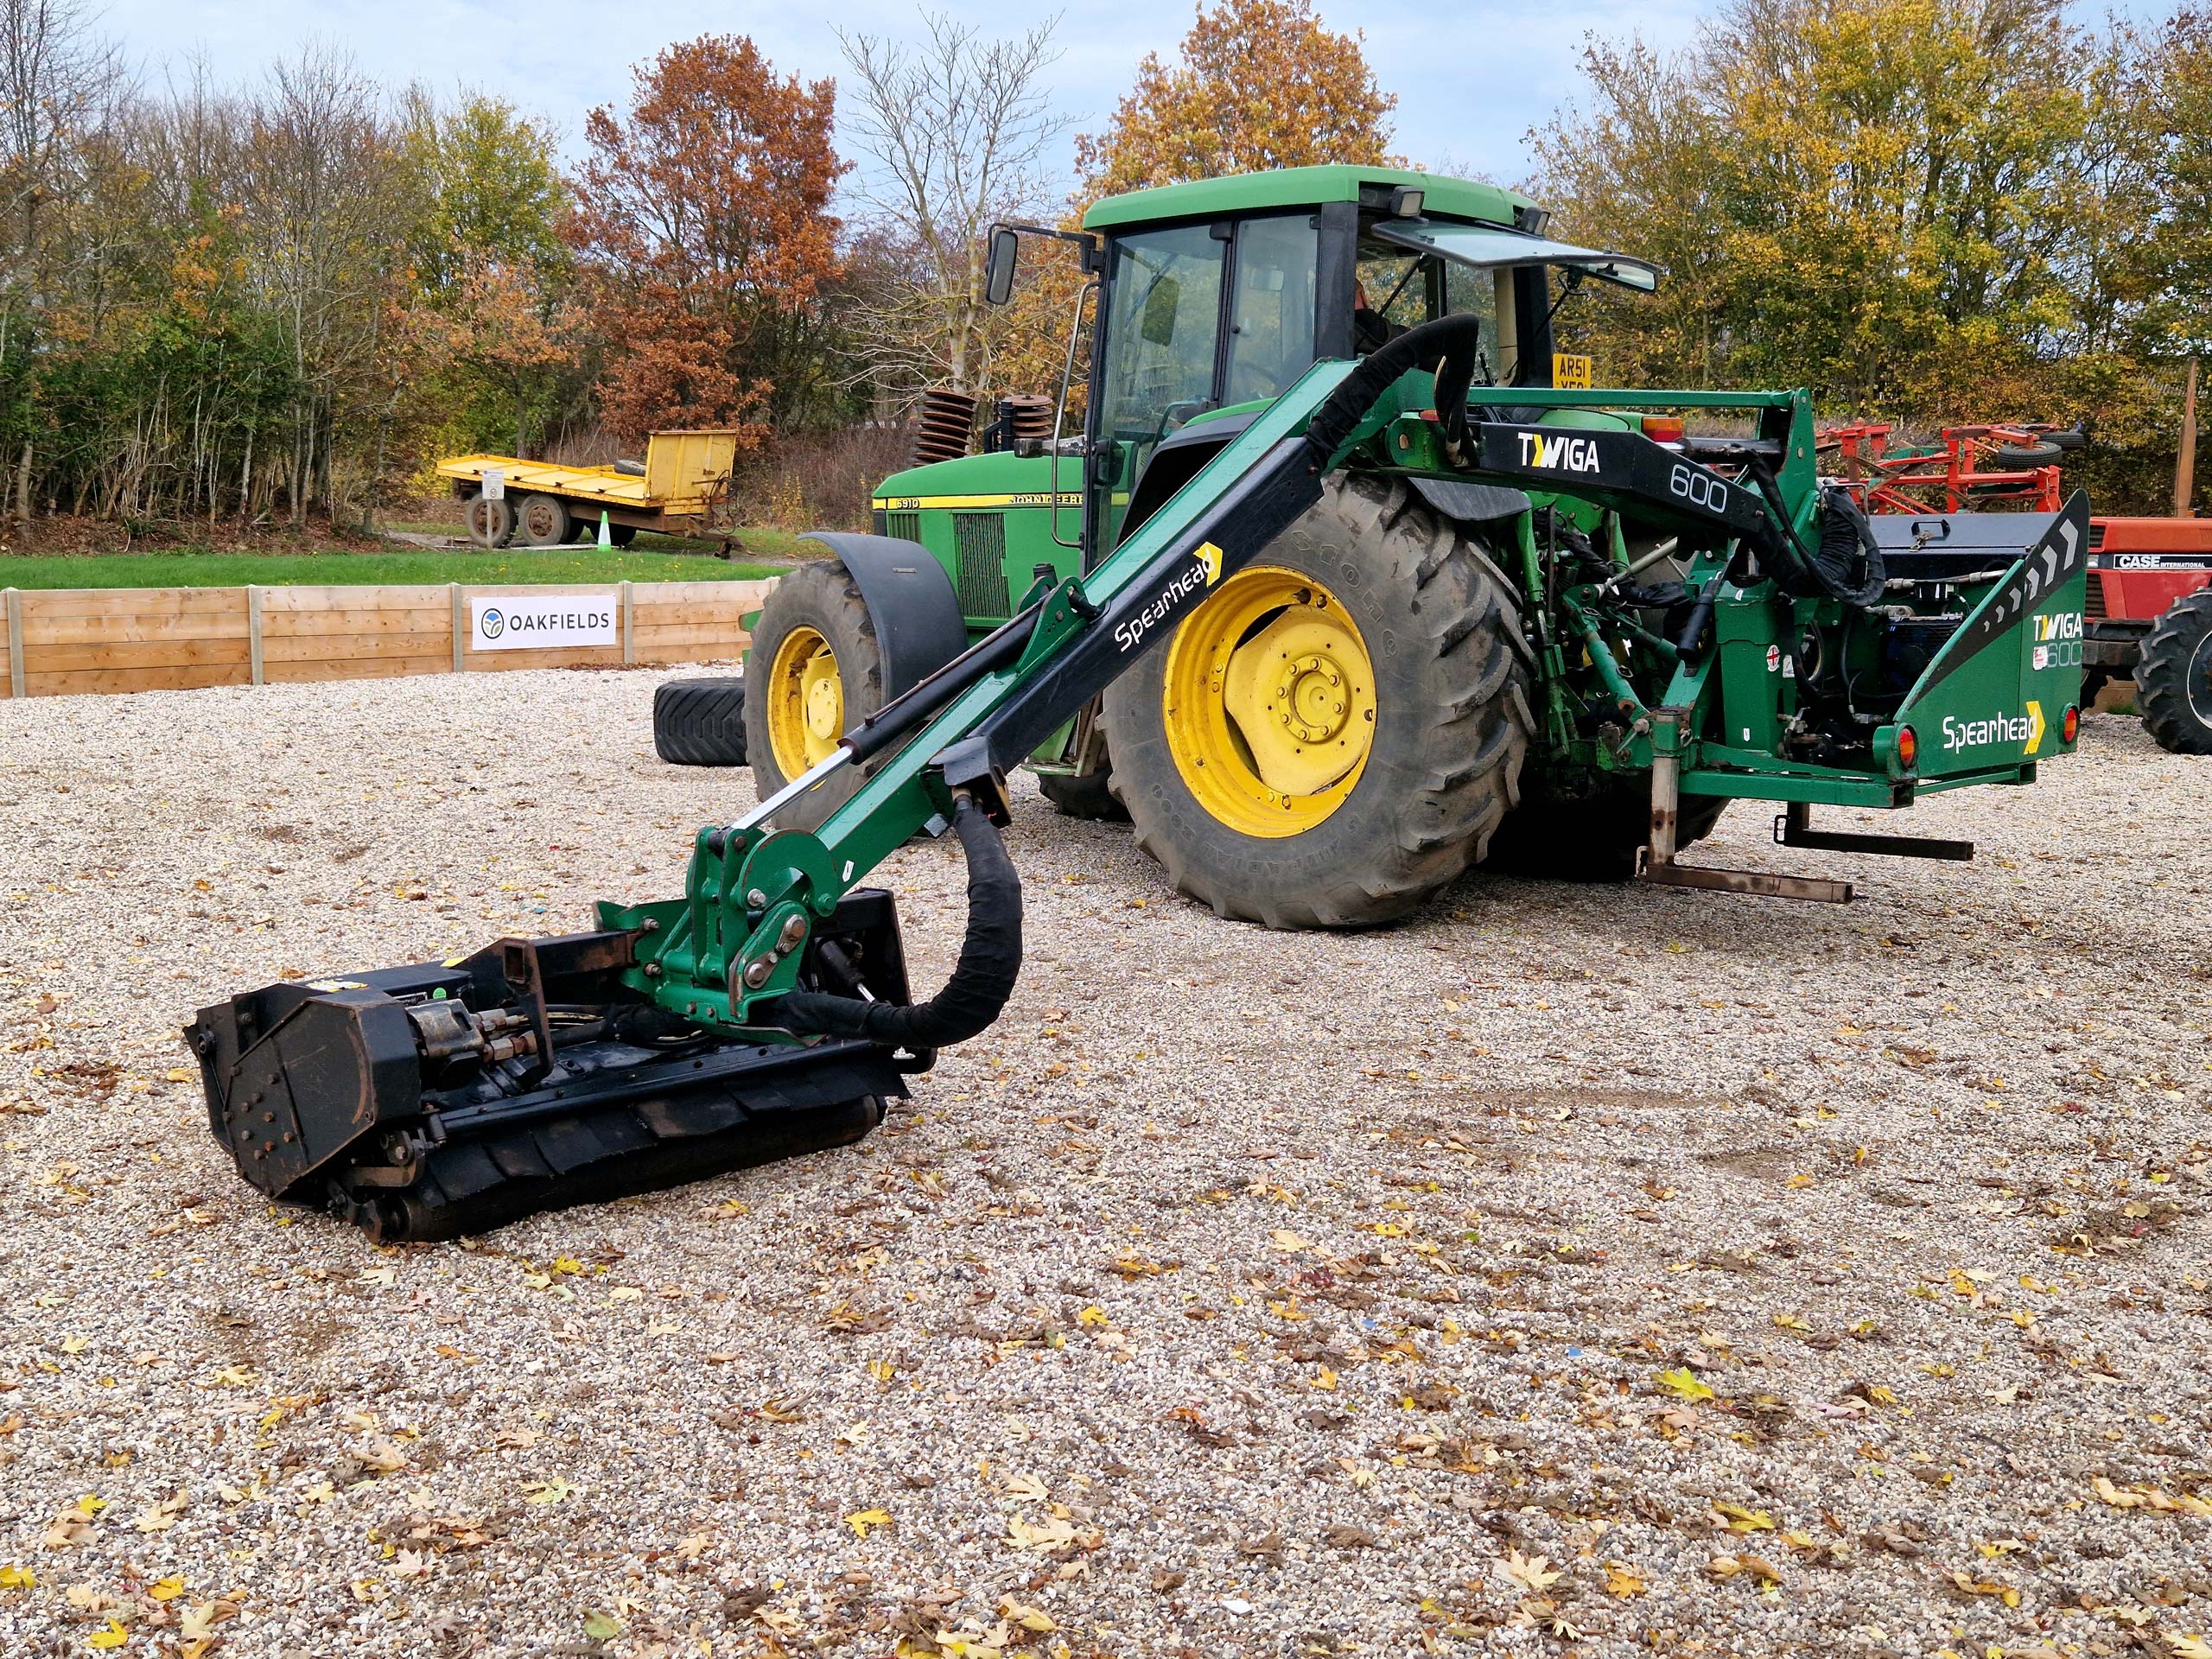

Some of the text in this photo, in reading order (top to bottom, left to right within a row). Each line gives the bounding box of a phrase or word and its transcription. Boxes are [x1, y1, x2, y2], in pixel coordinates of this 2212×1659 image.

[1559, 357, 1586, 378] AR51
[1518, 432, 1727, 513] TWIGA 600
[897, 498, 919, 509] 6910
[1009, 493, 1044, 504] JOHN
[2119, 556, 2160, 568] CASE
[1114, 546, 1216, 652] Spearhead
[510, 613, 609, 631] OAKFIELDS
[2033, 612, 2083, 641] TWIGA
[2047, 640, 2082, 668] 600
[1942, 708, 2037, 754] Spearhead
